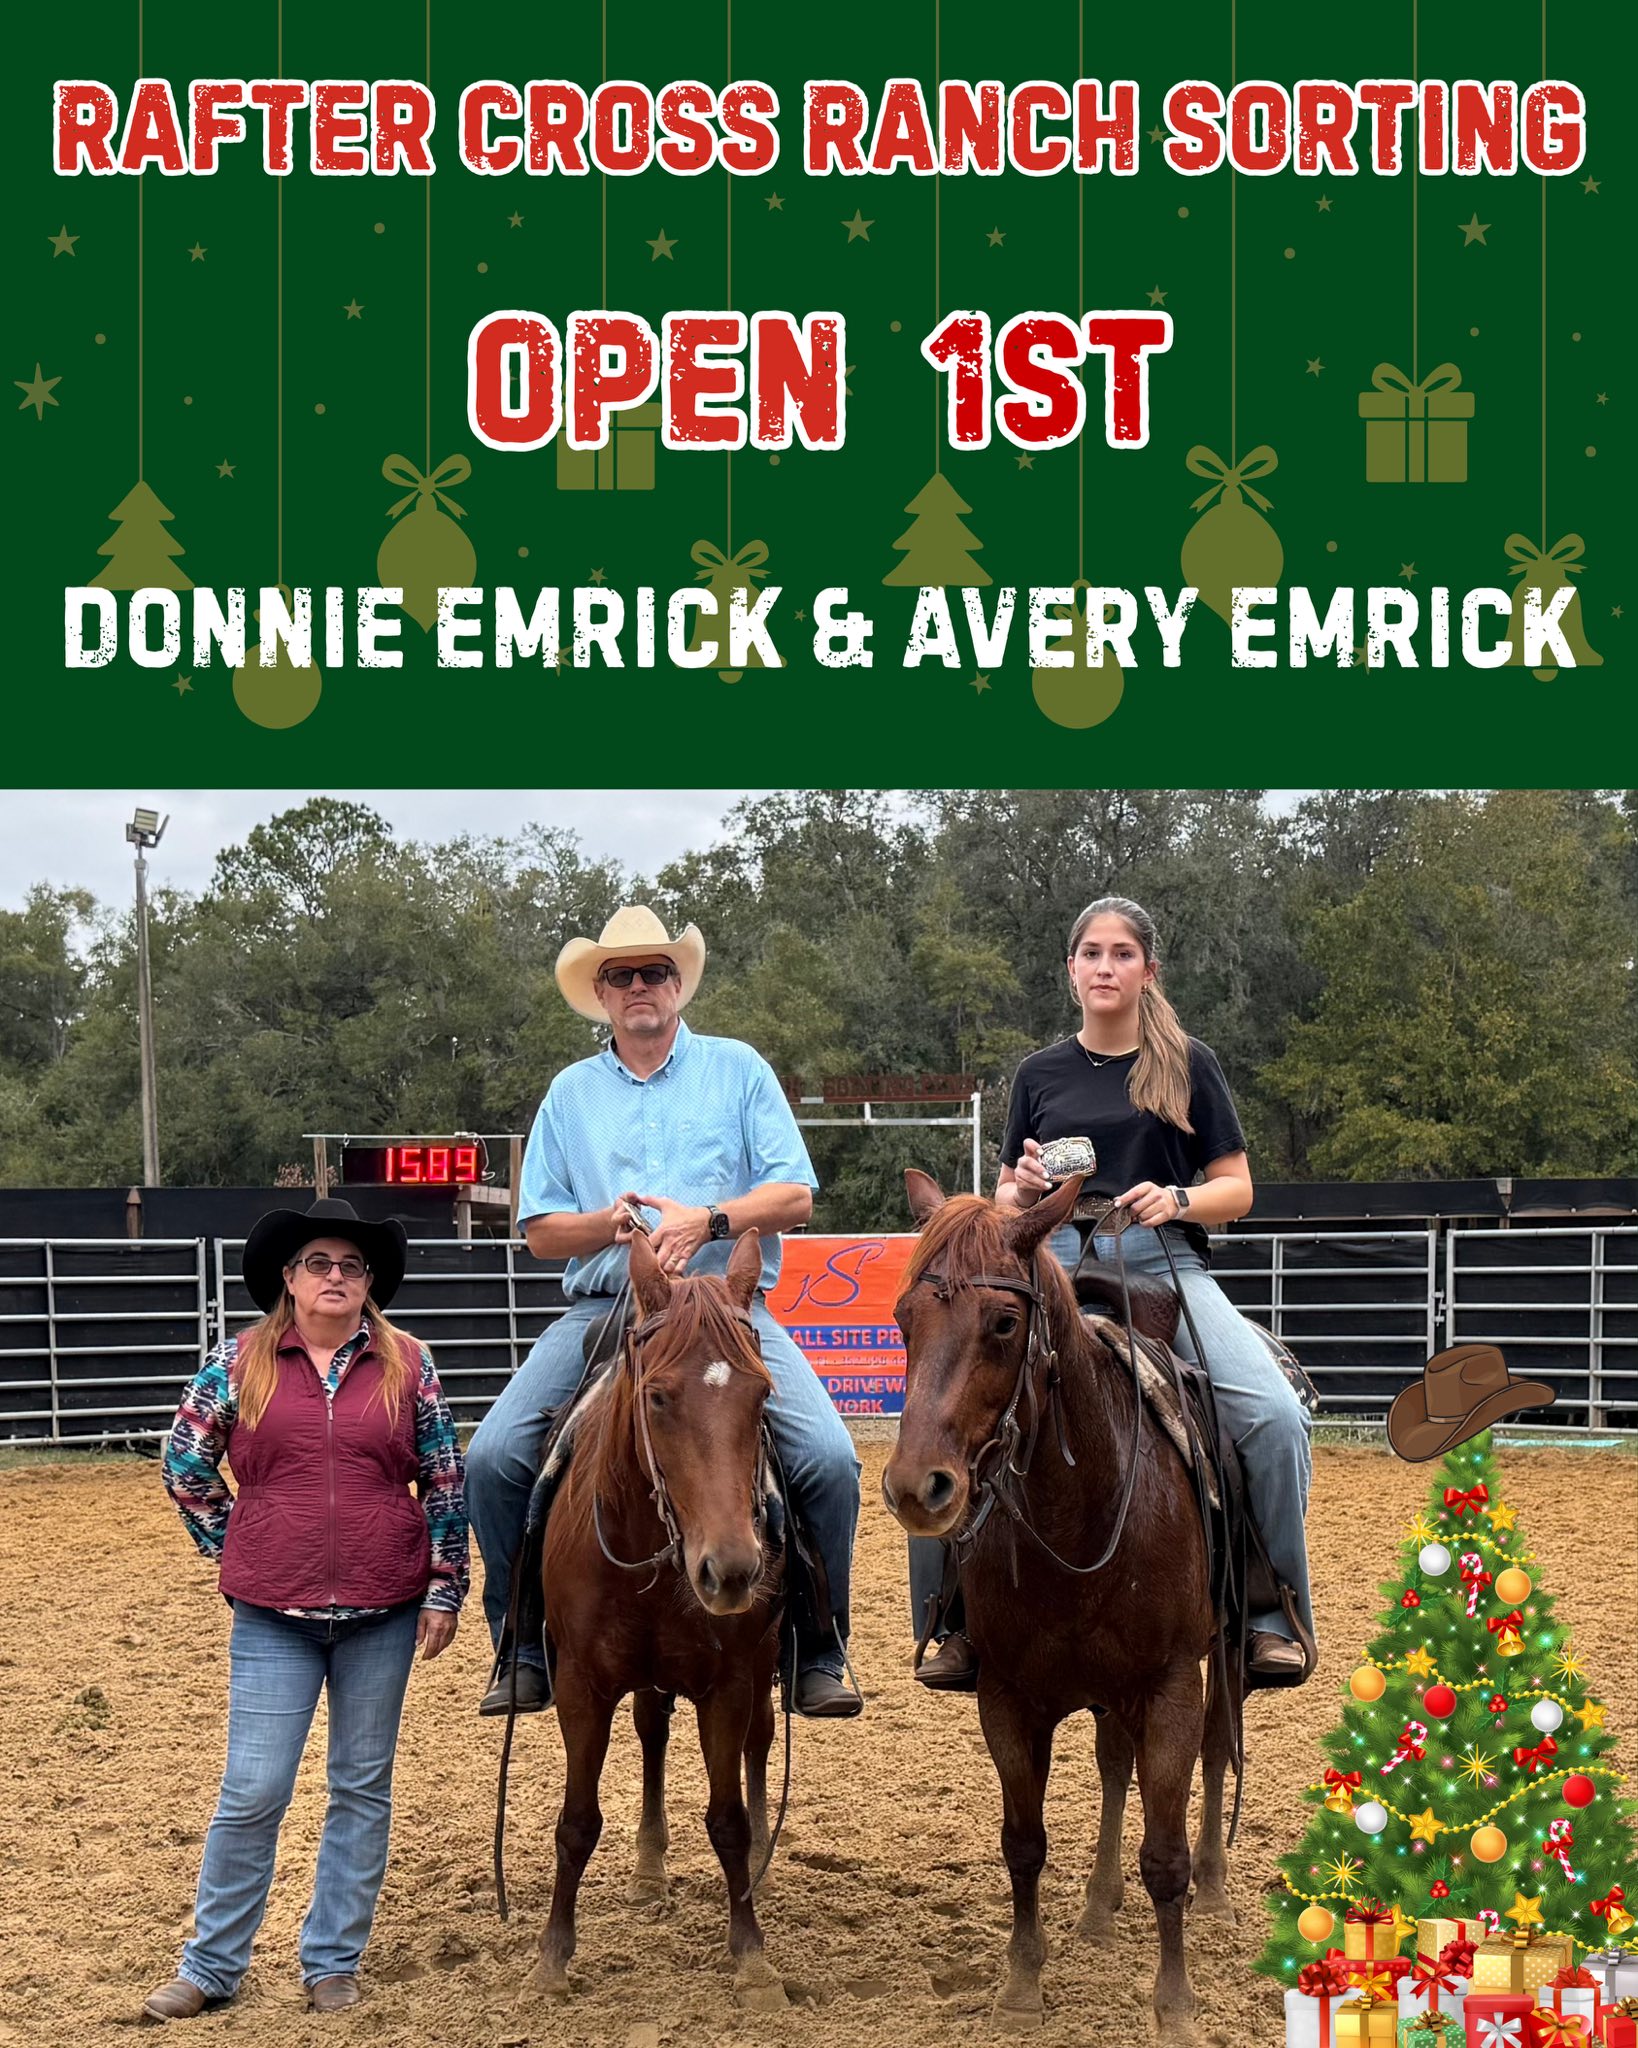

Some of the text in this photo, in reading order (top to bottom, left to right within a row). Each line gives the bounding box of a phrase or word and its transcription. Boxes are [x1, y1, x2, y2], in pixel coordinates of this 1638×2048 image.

[386, 1147, 477, 1182] 15.89
[831, 1329, 872, 1345] SITE
[877, 1329, 905, 1345] PR
[827, 1377, 906, 1394] DRIVEW
